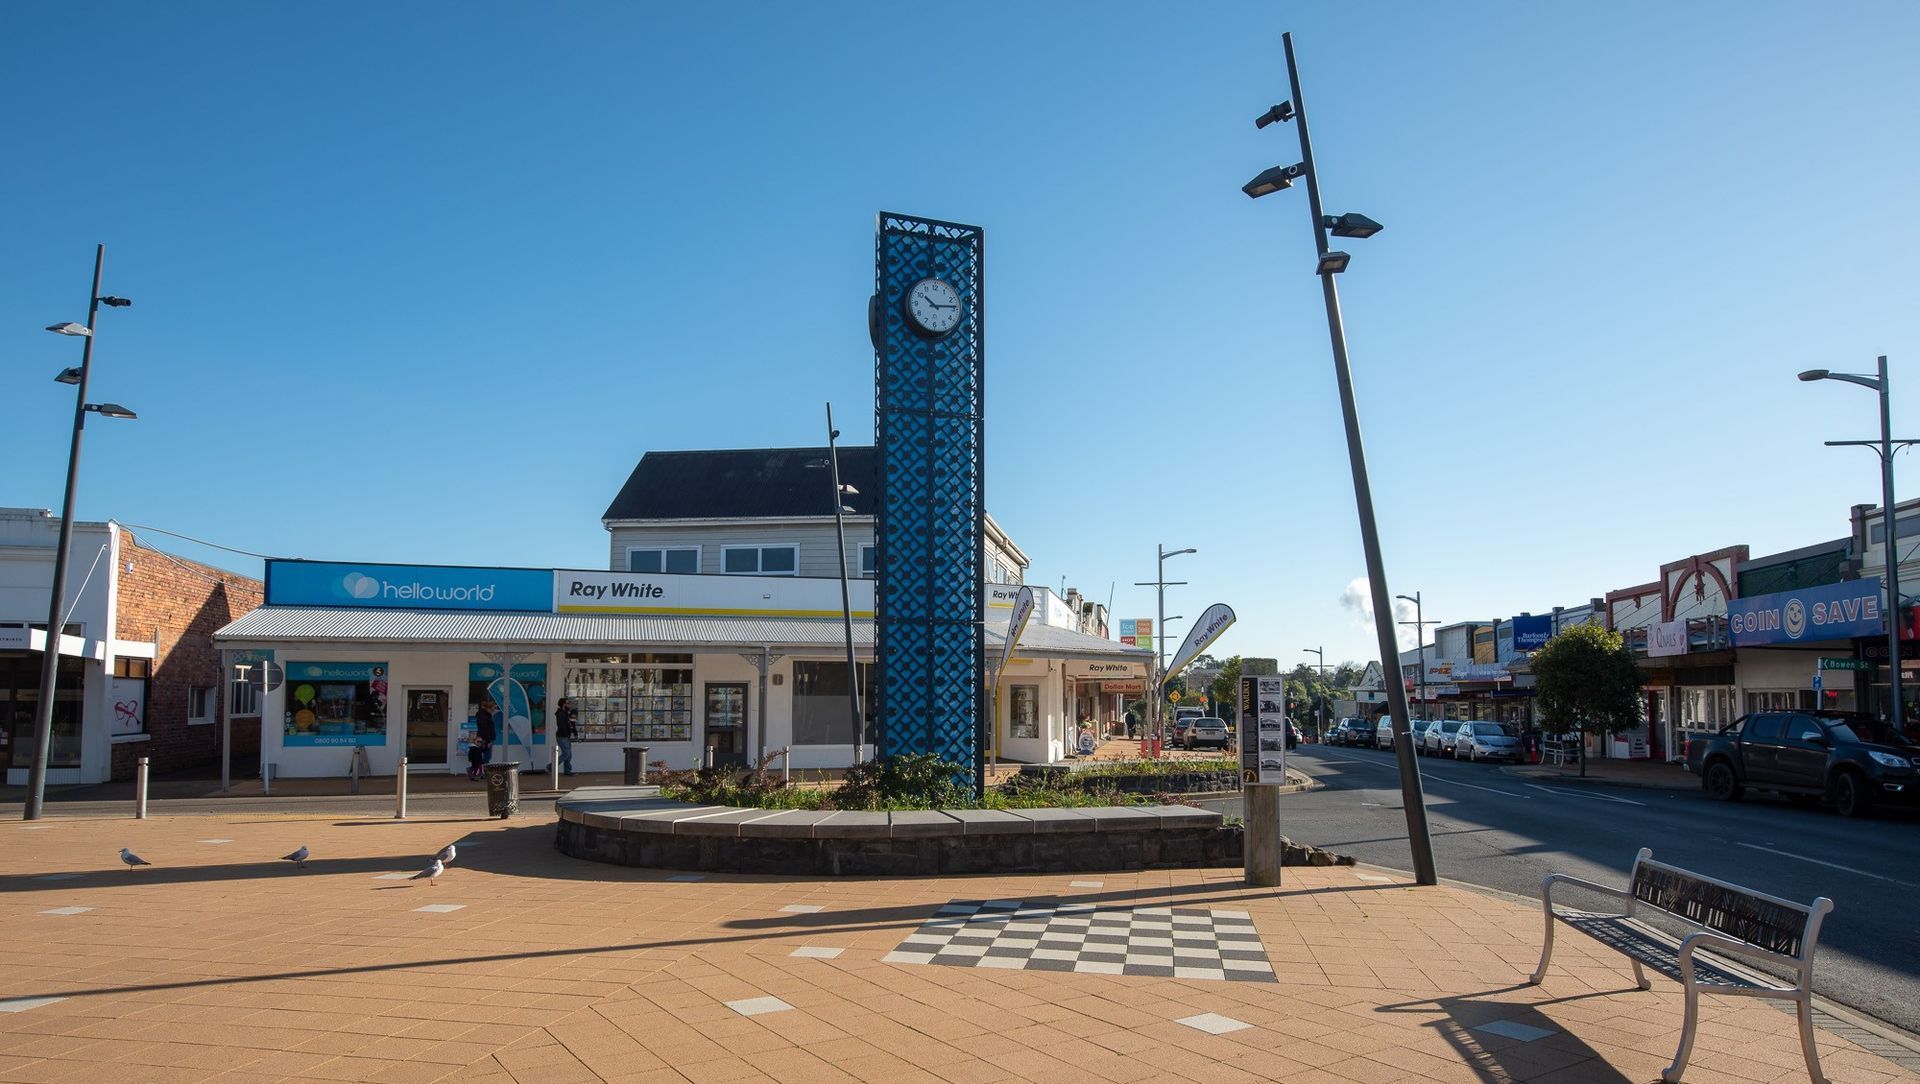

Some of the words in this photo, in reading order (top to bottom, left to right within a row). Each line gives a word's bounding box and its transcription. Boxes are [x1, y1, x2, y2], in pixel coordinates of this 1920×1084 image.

[569, 581, 608, 600] Ray
[611, 582, 664, 599] White
[992, 590, 1008, 600] Ray
[1731, 608, 1780, 634] COIN
[1812, 595, 1879, 625] SAVE
[1194, 632, 1208, 647] Ray
[1206, 614, 1228, 634] White
[1089, 664, 1104, 672] Ray
[1830, 660, 1855, 668] Bowen
[1860, 661, 1869, 669] St
